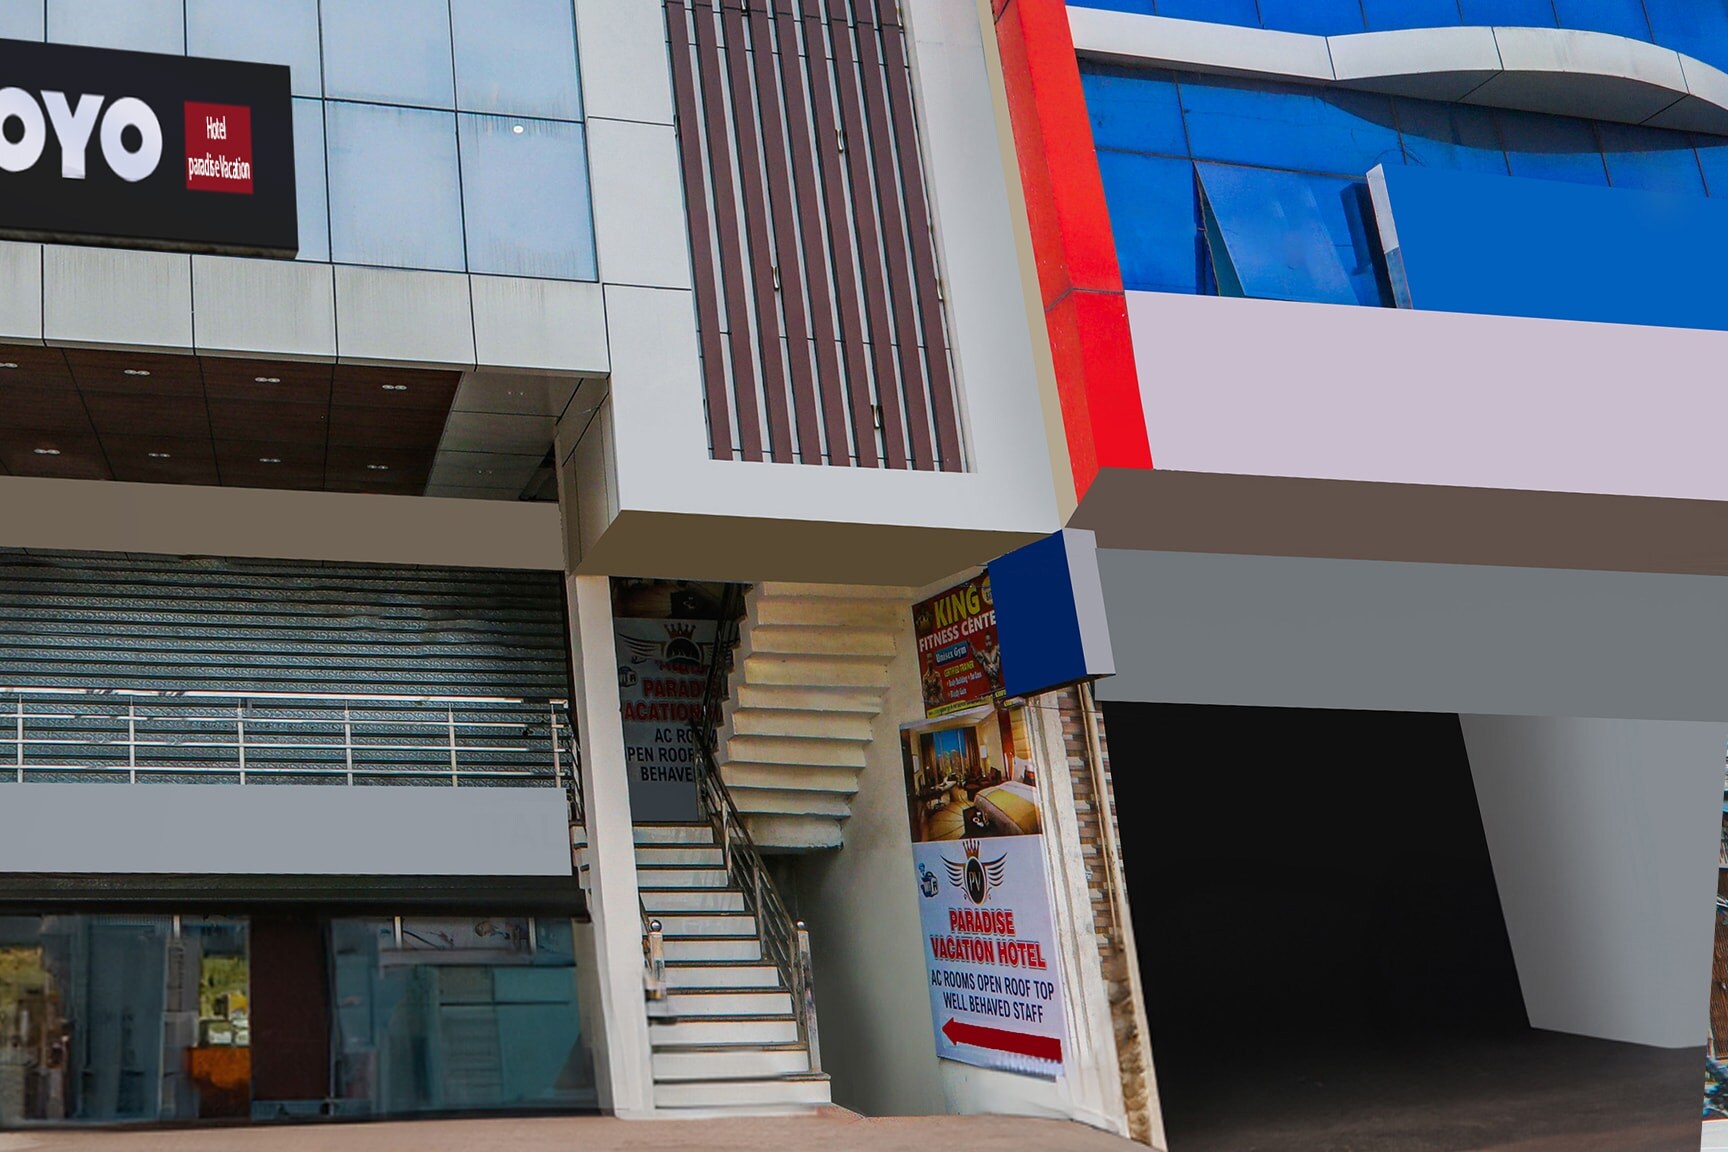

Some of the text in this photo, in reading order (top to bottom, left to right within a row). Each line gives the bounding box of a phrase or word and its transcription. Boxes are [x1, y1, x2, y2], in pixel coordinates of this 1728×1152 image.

[206, 115, 227, 140] Hotel
[934, 585, 981, 629] KING
[919, 609, 997, 652] FITNESS CENTE
[953, 646, 967, 659] Gym
[642, 678, 723, 699] PARAD
[623, 699, 702, 722] ACATION
[655, 728, 672, 743] AC
[627, 746, 654, 762] PEN
[640, 765, 694, 783] BEHAVE
[948, 908, 1016, 936] PARADISE
[930, 934, 1048, 970] VACATION HOTEL
[932, 969, 1055, 1000] AC ROOMS OPEN ROOF TOP
[943, 991, 1043, 1023] WELL BEHAVED STAFF
